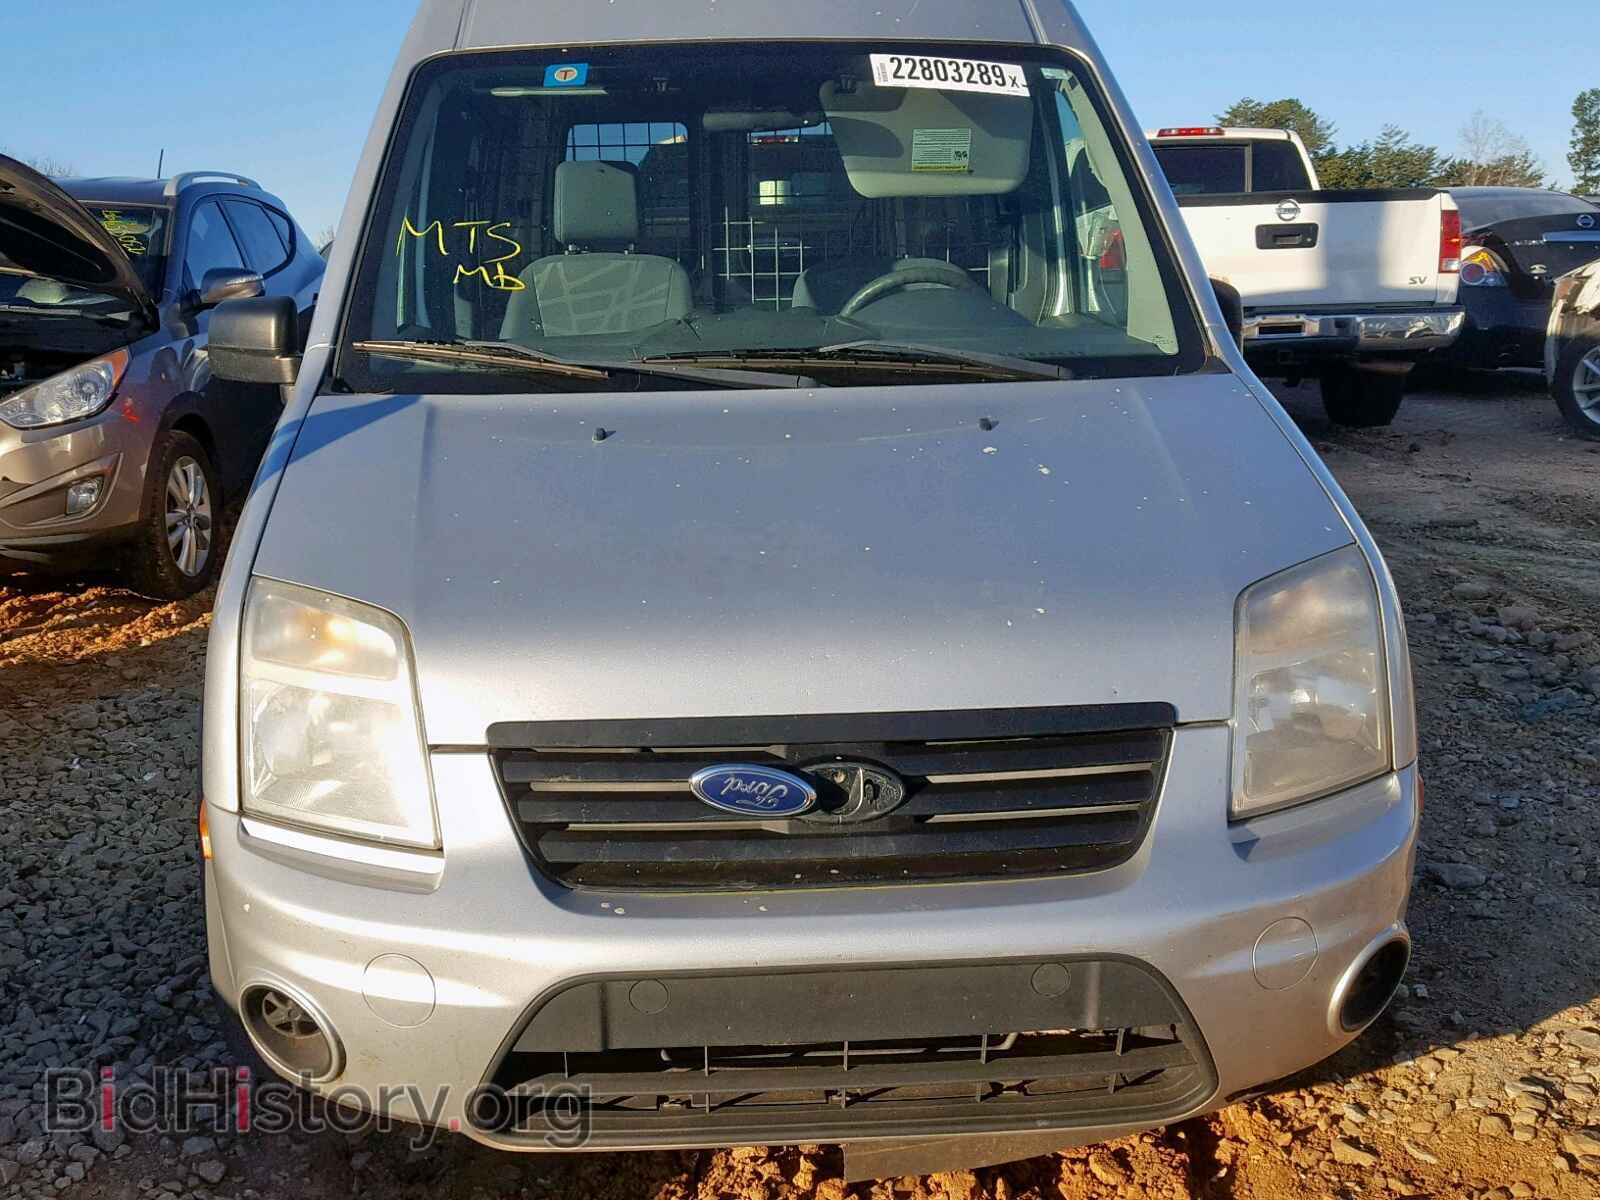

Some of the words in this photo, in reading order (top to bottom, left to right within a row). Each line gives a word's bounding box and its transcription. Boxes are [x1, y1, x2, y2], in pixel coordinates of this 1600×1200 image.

[889, 56, 1006, 87] 22803289
[1408, 275, 1428, 285] SV
[720, 774, 789, 810] Ford
